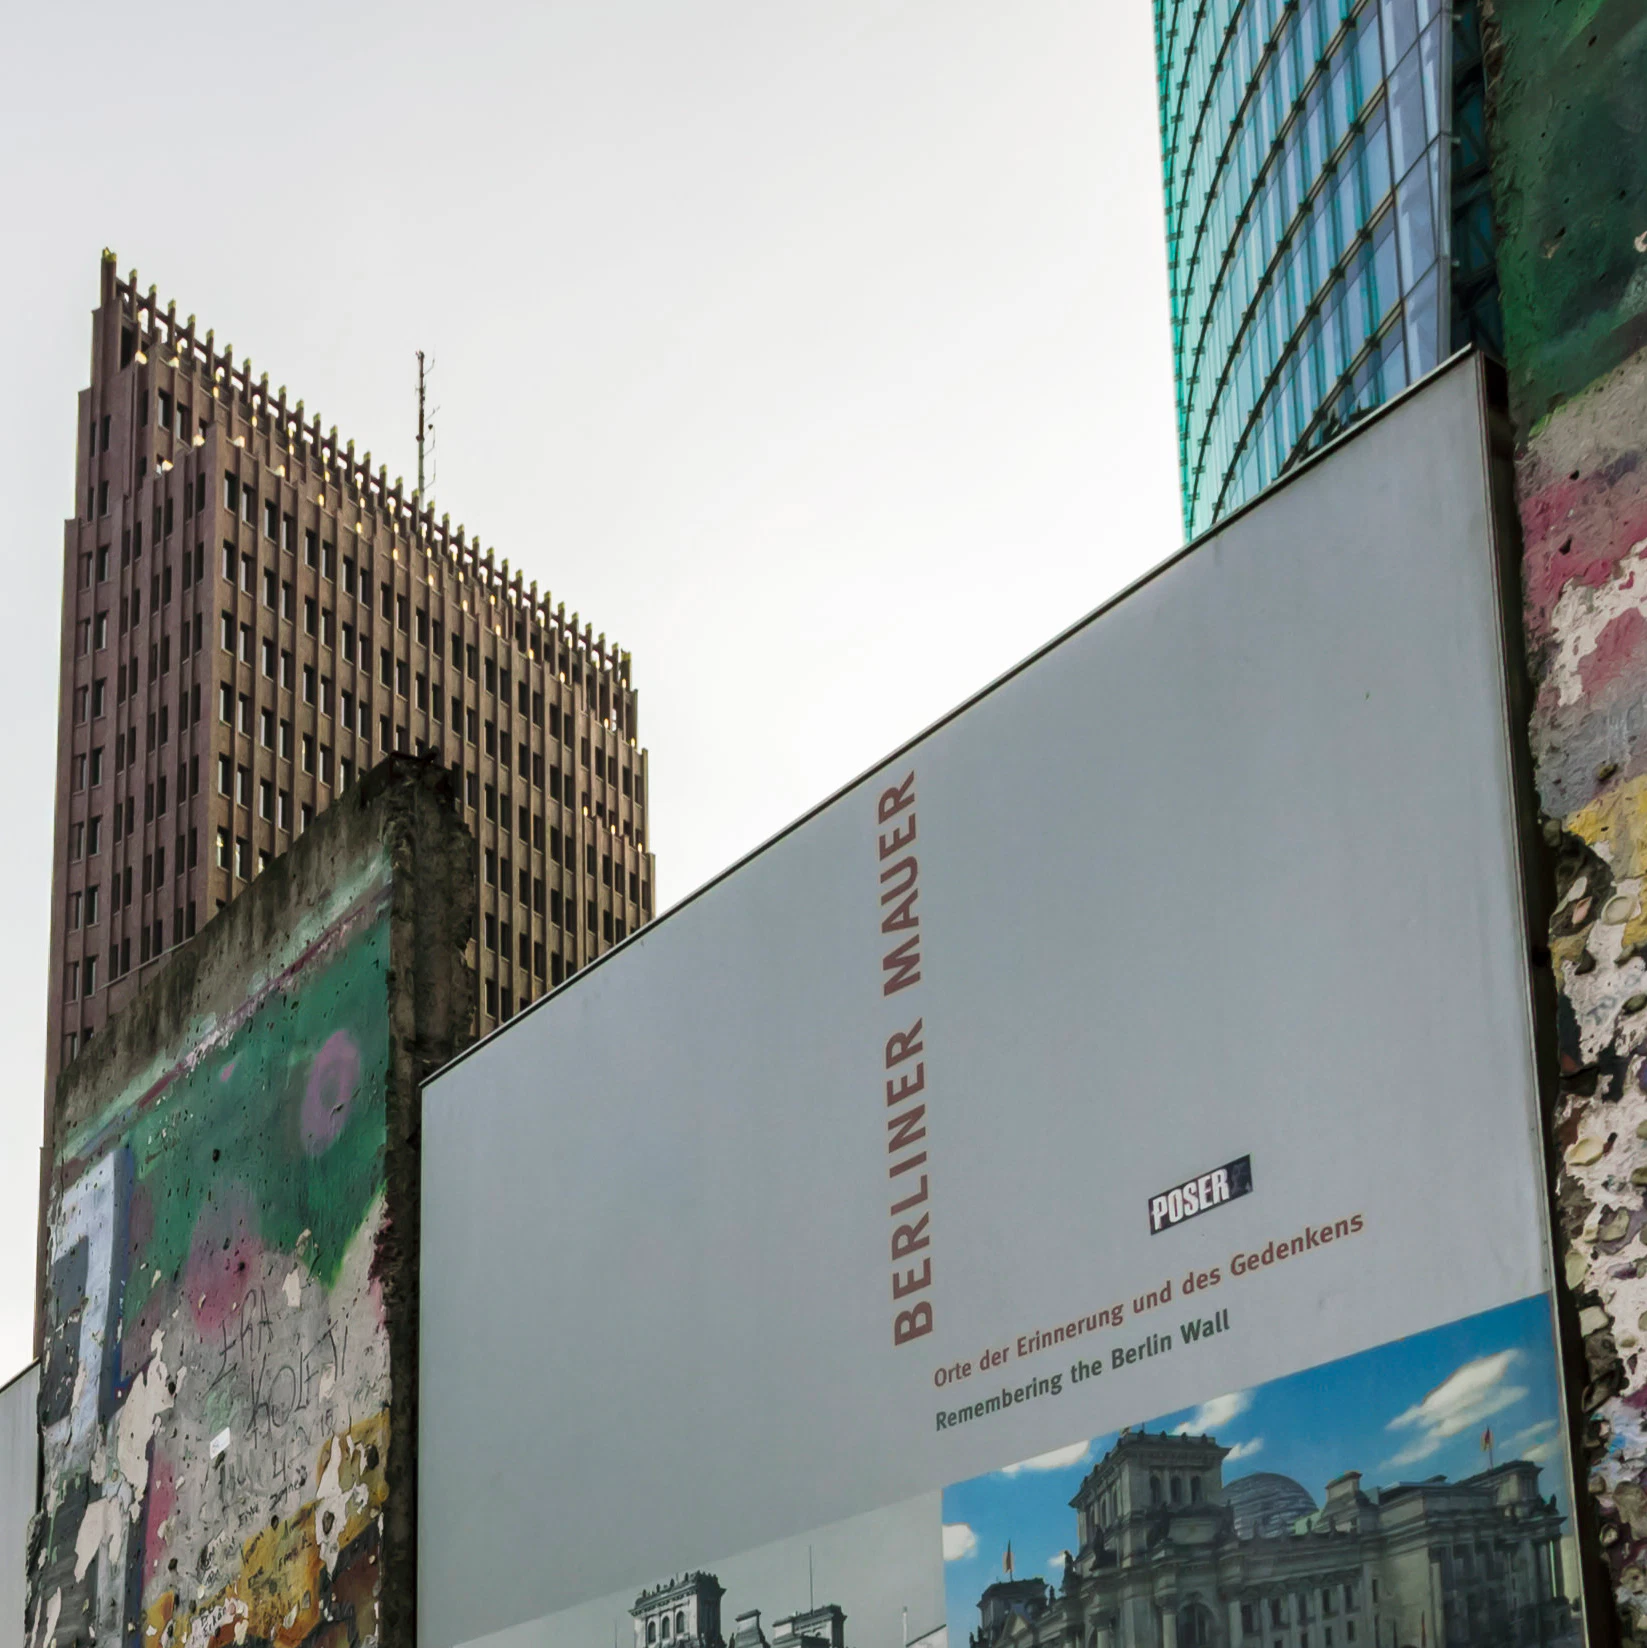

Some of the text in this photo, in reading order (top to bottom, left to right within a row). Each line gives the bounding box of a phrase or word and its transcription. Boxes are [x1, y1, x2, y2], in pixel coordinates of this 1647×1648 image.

[877, 769, 933, 1346] BERLINER MAUER
[1151, 1168, 1230, 1231] POSER
[934, 1213, 1364, 1388] Orte der Erinnerung und des Gedenkens
[935, 1307, 1231, 1432] Remembering the Berlin Wall
